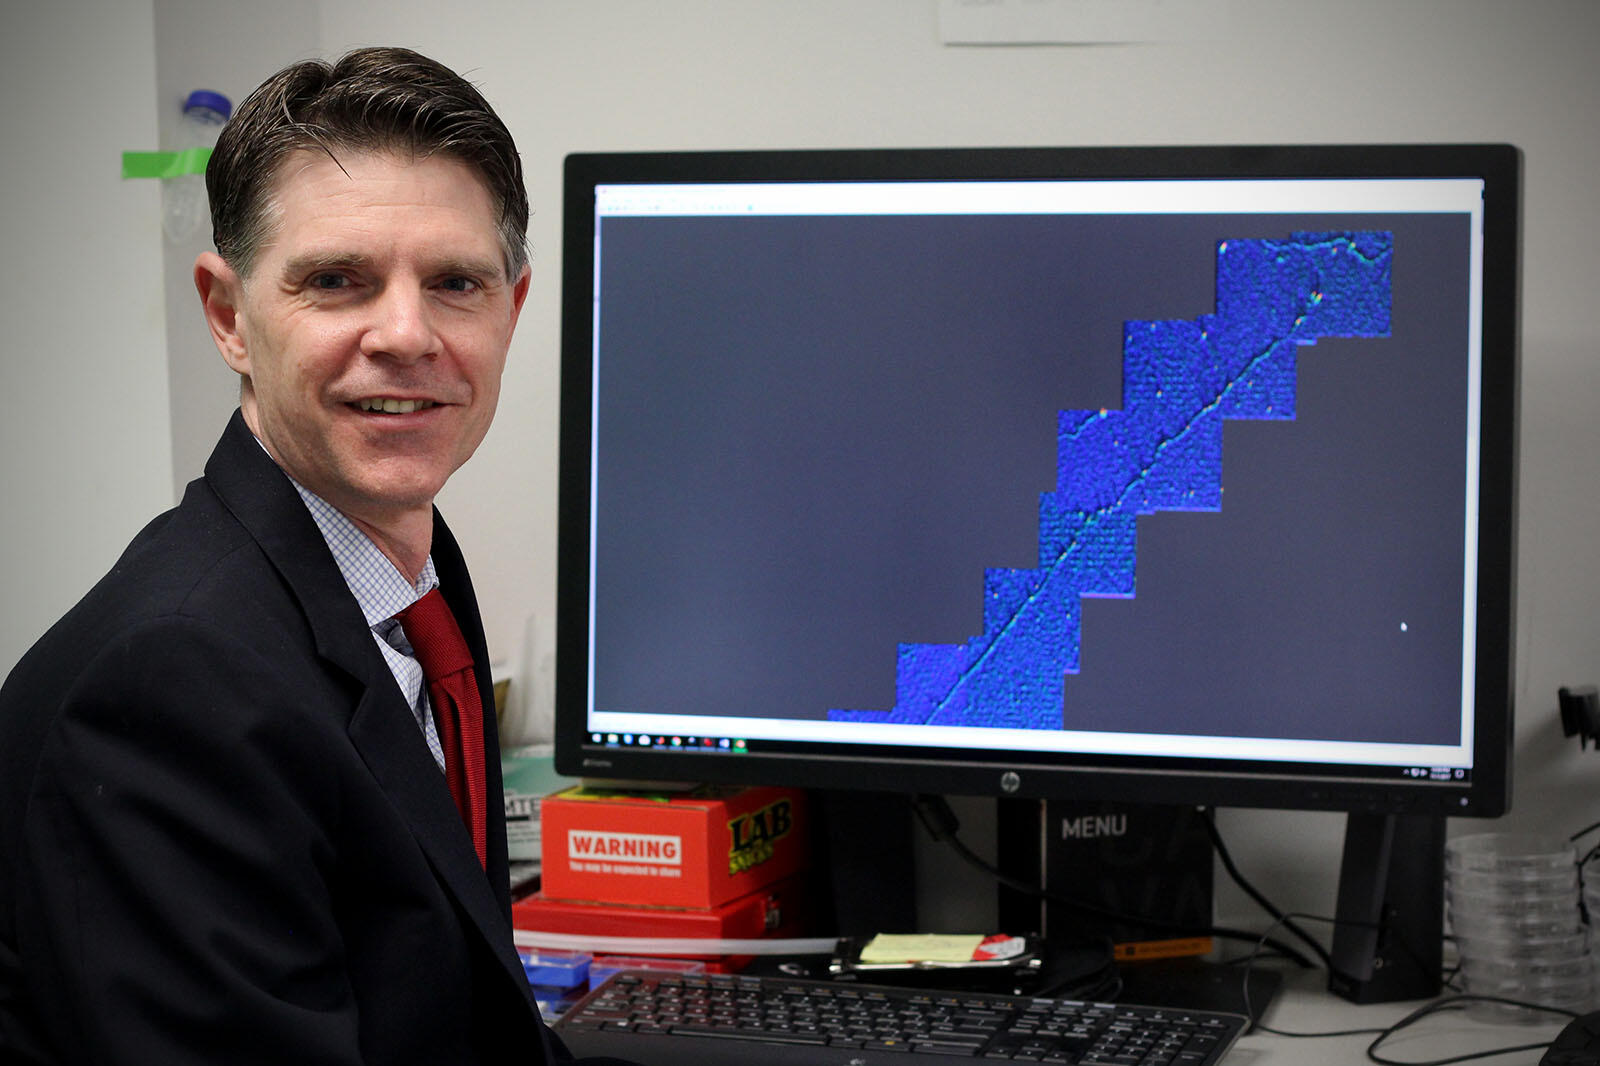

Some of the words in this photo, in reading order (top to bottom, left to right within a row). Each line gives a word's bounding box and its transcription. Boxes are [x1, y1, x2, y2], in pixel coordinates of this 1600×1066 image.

[729, 799, 792, 852] LAB
[1062, 814, 1127, 840] MENU
[573, 835, 676, 859] WARNING
